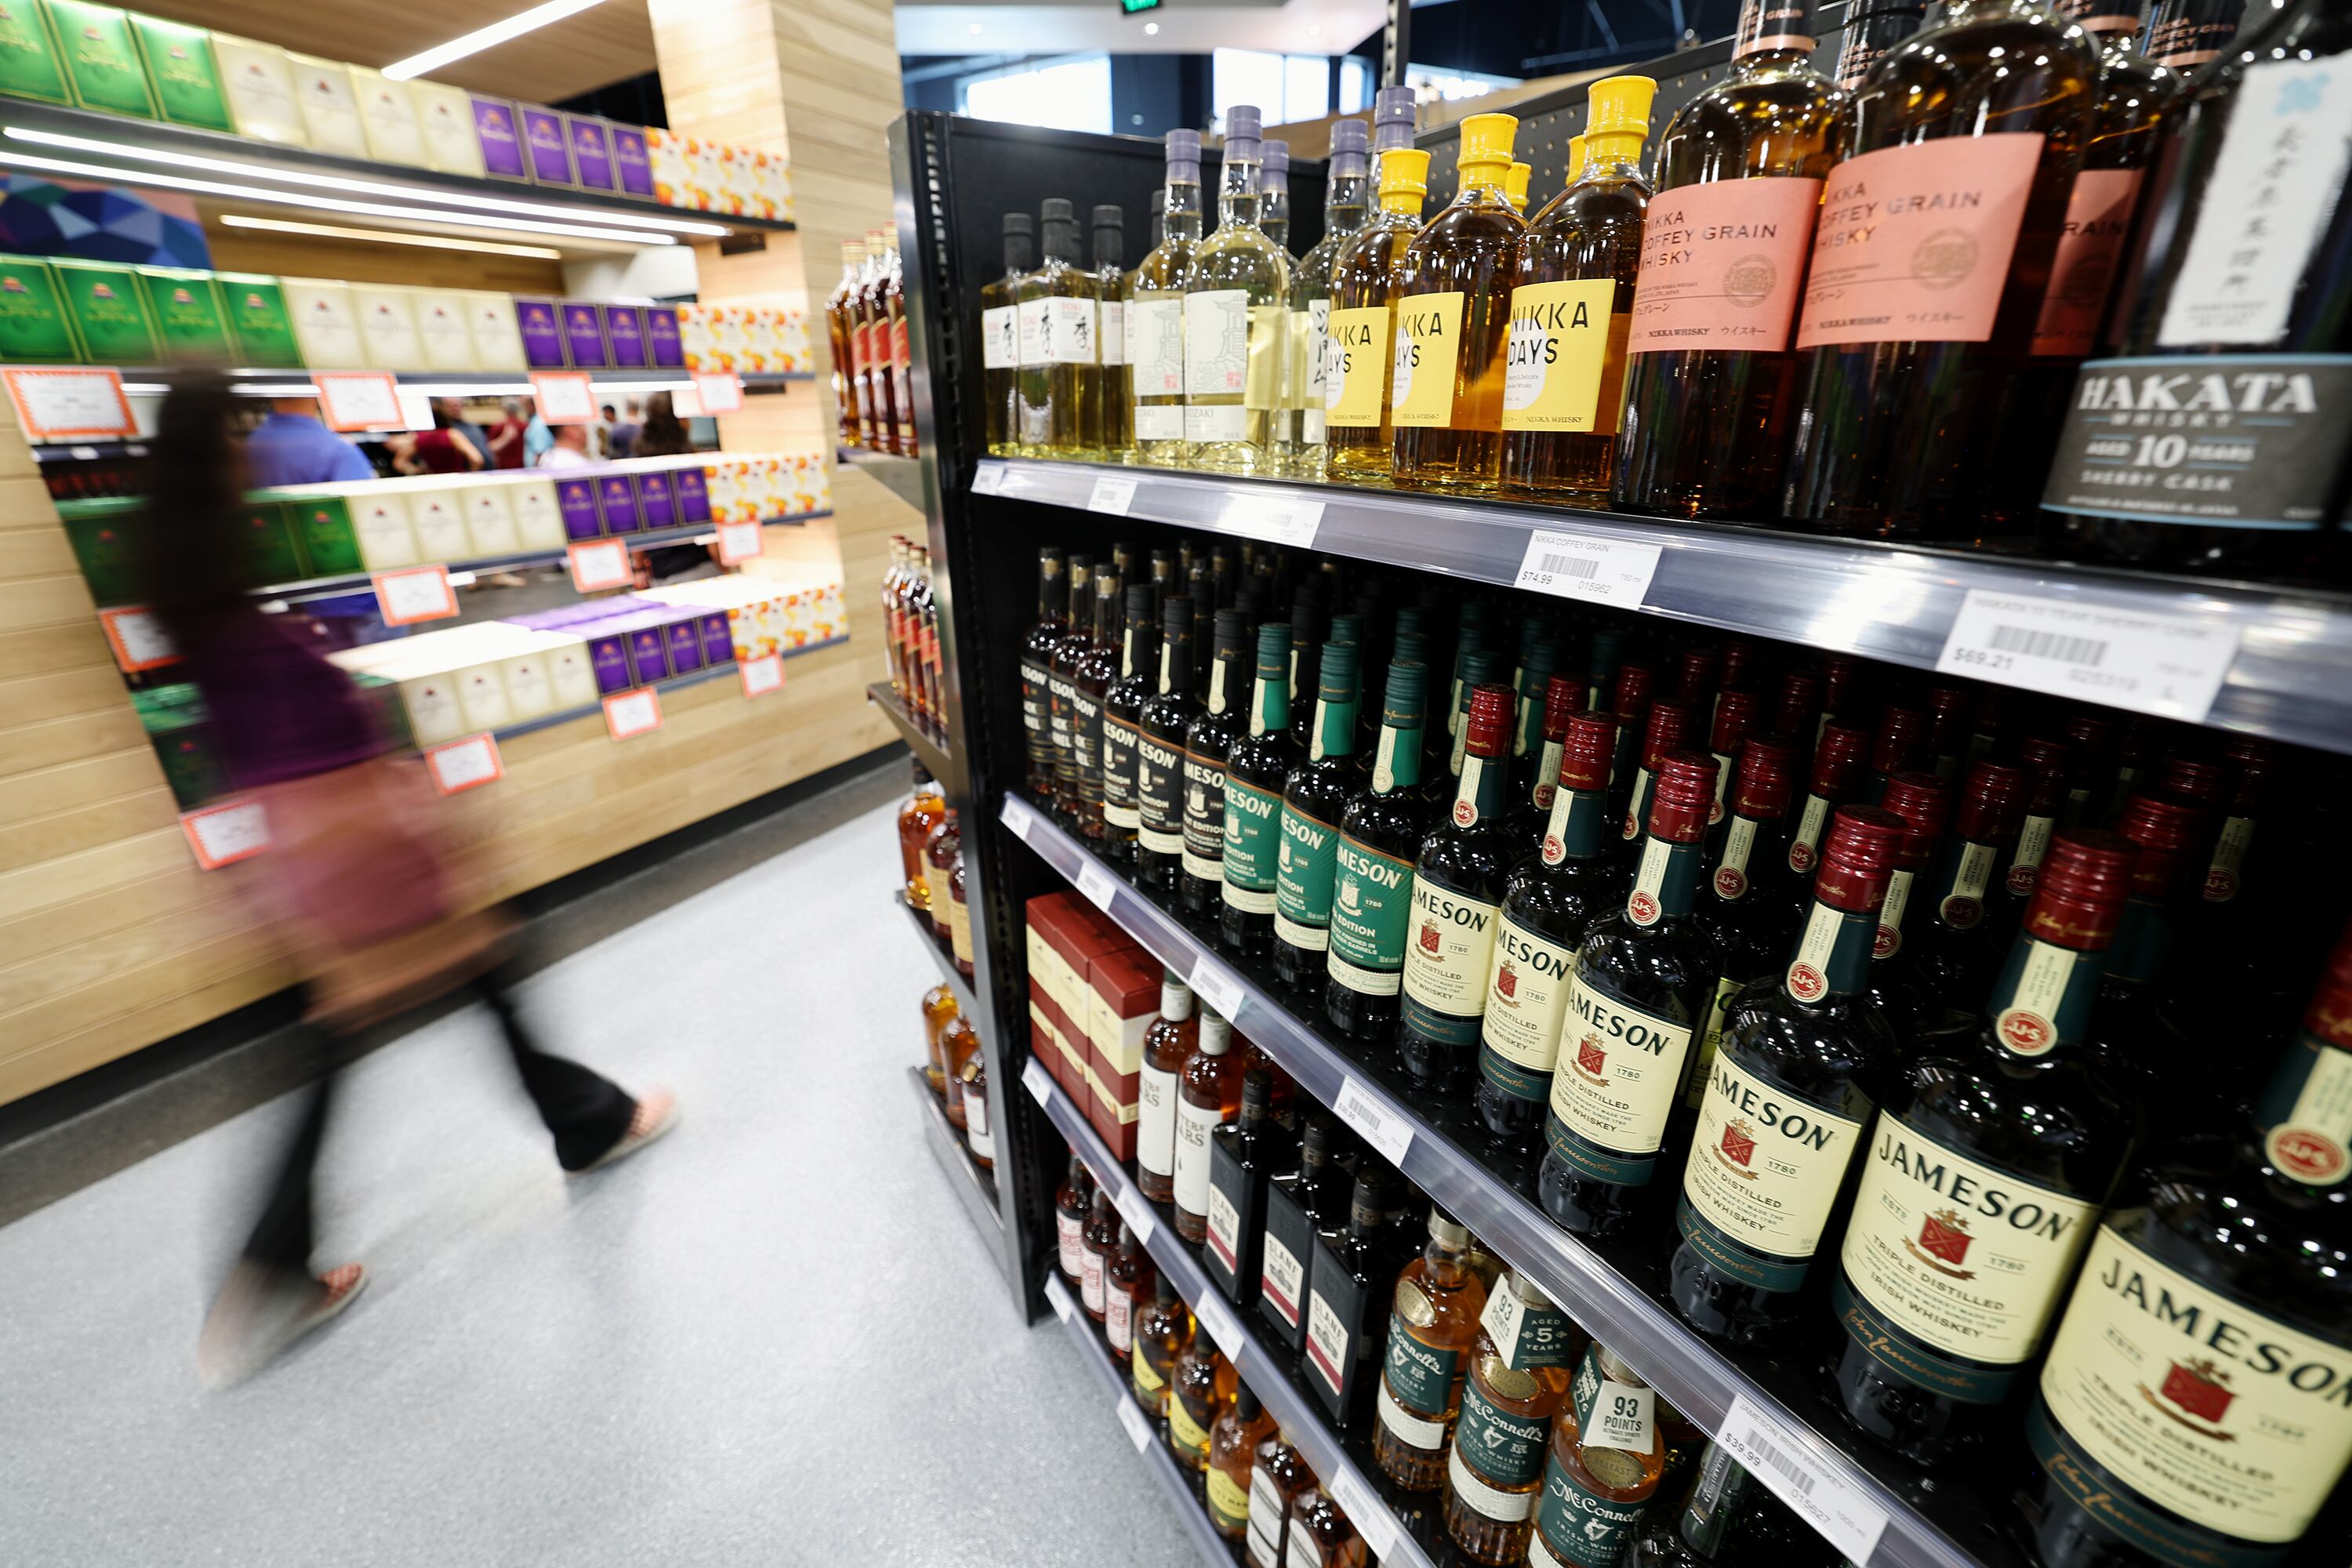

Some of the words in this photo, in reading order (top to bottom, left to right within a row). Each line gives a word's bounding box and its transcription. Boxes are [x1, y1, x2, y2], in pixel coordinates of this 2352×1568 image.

[1887, 191, 1982, 214] GRAIN
[1702, 224, 1777, 240] GRAIN
[1512, 301, 1588, 333] NIKKA
[1648, 328, 1673, 337] NIKKA
[1722, 326, 1766, 336] ウイスキー
[1509, 338, 1559, 366] DAYS
[2078, 372, 2318, 414] HAKATA
[2132, 433, 2188, 469] 10
[1535, 534, 1555, 544] NIKKA
[1555, 538, 1584, 548] COFFEY
[1586, 543, 1610, 552] GRAIN
[1522, 571, 1553, 585] $74.99
[1577, 581, 1612, 593] 015962
[1954, 646, 2015, 670] $69.21
[1184, 760, 1226, 788] MESO
[1365, 899, 1382, 908] 1780
[1338, 913, 1376, 938] EDITION
[1450, 945, 1468, 953] 1780
[1422, 962, 1461, 980] DISTILLED
[1419, 983, 1454, 1000] WHISKEY
[1526, 991, 1545, 1002] 1780
[1496, 1007, 1537, 1031] DISTILLED
[1494, 1029, 1529, 1051] WHISKEY
[1617, 1067, 1640, 1079] 1780
[1578, 1083, 1629, 1111] DISTILLED
[1573, 1106, 1617, 1132] WHISKEY
[1768, 1160, 1797, 1175] 1780
[1722, 1174, 1782, 1208] DISTILLED
[1879, 1133, 2073, 1242] JAMESON
[1713, 1197, 1766, 1231] WHISKEY
[1874, 1235, 1917, 1275] TRIPLE
[1920, 1273, 2005, 1311] DISTILLED
[1989, 1255, 2026, 1272] 1780
[1498, 1294, 1514, 1319] 93
[1871, 1272, 1905, 1303] IRISH
[1909, 1300, 1984, 1338] WHISKEY
[1526, 1342, 1562, 1352] YEARS
[1536, 1327, 1553, 1344] 5
[1613, 1396, 1639, 1418] 93
[1604, 1415, 1642, 1432] POINTS
[1488, 1450, 1526, 1465] WHISKY
[1724, 1432, 1761, 1467] $39.99
[2160, 1426, 2275, 1481] DISTILLED
[2143, 1458, 2243, 1511] WHISKEY
[1791, 1488, 1831, 1523] 015627
